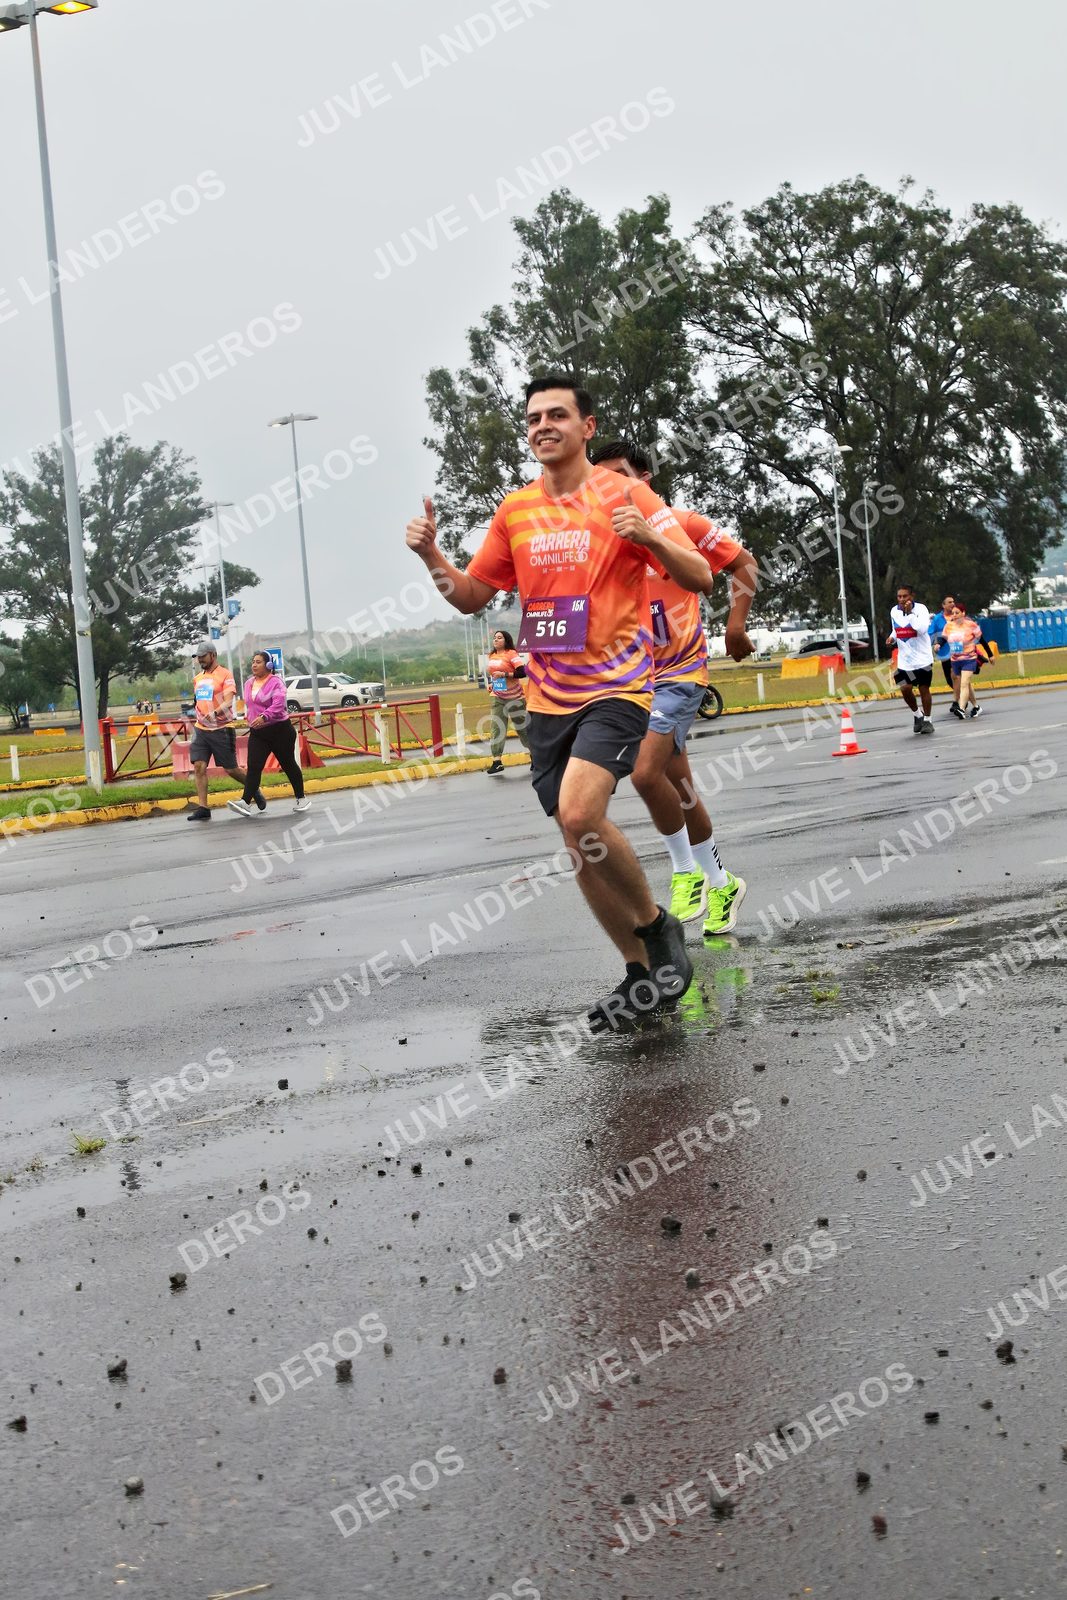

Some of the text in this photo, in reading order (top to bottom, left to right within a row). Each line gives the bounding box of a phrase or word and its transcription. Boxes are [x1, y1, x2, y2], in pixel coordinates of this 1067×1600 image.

[530, 530, 591, 553] CARRERA
[530, 551, 574, 566] OMNILIFE
[527, 601, 555, 611] CARRERA
[571, 599, 585, 612] 15K
[535, 620, 567, 637] 516
